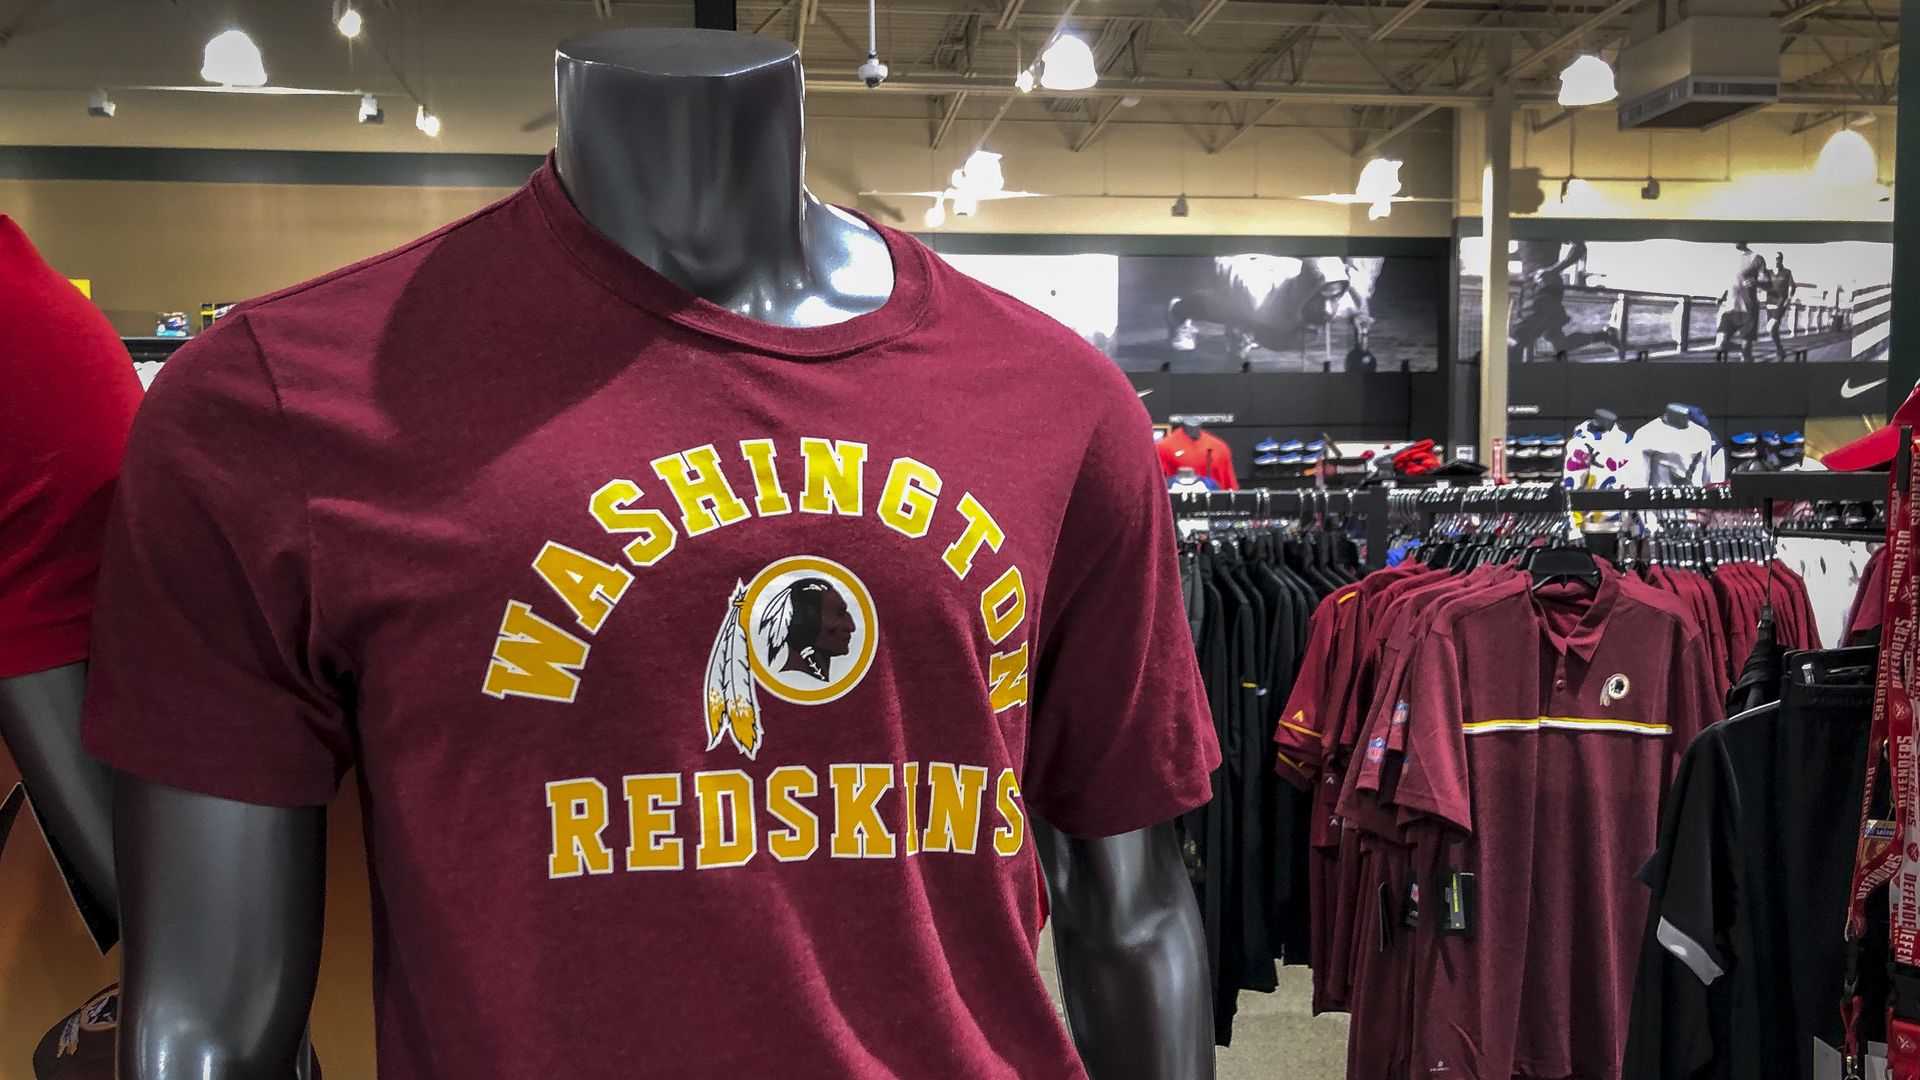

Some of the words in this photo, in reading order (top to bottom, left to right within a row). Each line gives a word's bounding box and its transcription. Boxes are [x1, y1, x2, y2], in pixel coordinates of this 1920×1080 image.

[482, 437, 1028, 713] WASHINGTON
[1874, 650, 1888, 720] DEFENDERS
[1890, 616, 1912, 689] DEFENDERS
[1897, 735, 1914, 808] DEFENDERS
[545, 761, 1024, 878] REDSKINS
[1856, 853, 1902, 901] DEFENDERS
[1902, 873, 1917, 928] DEFENDE
